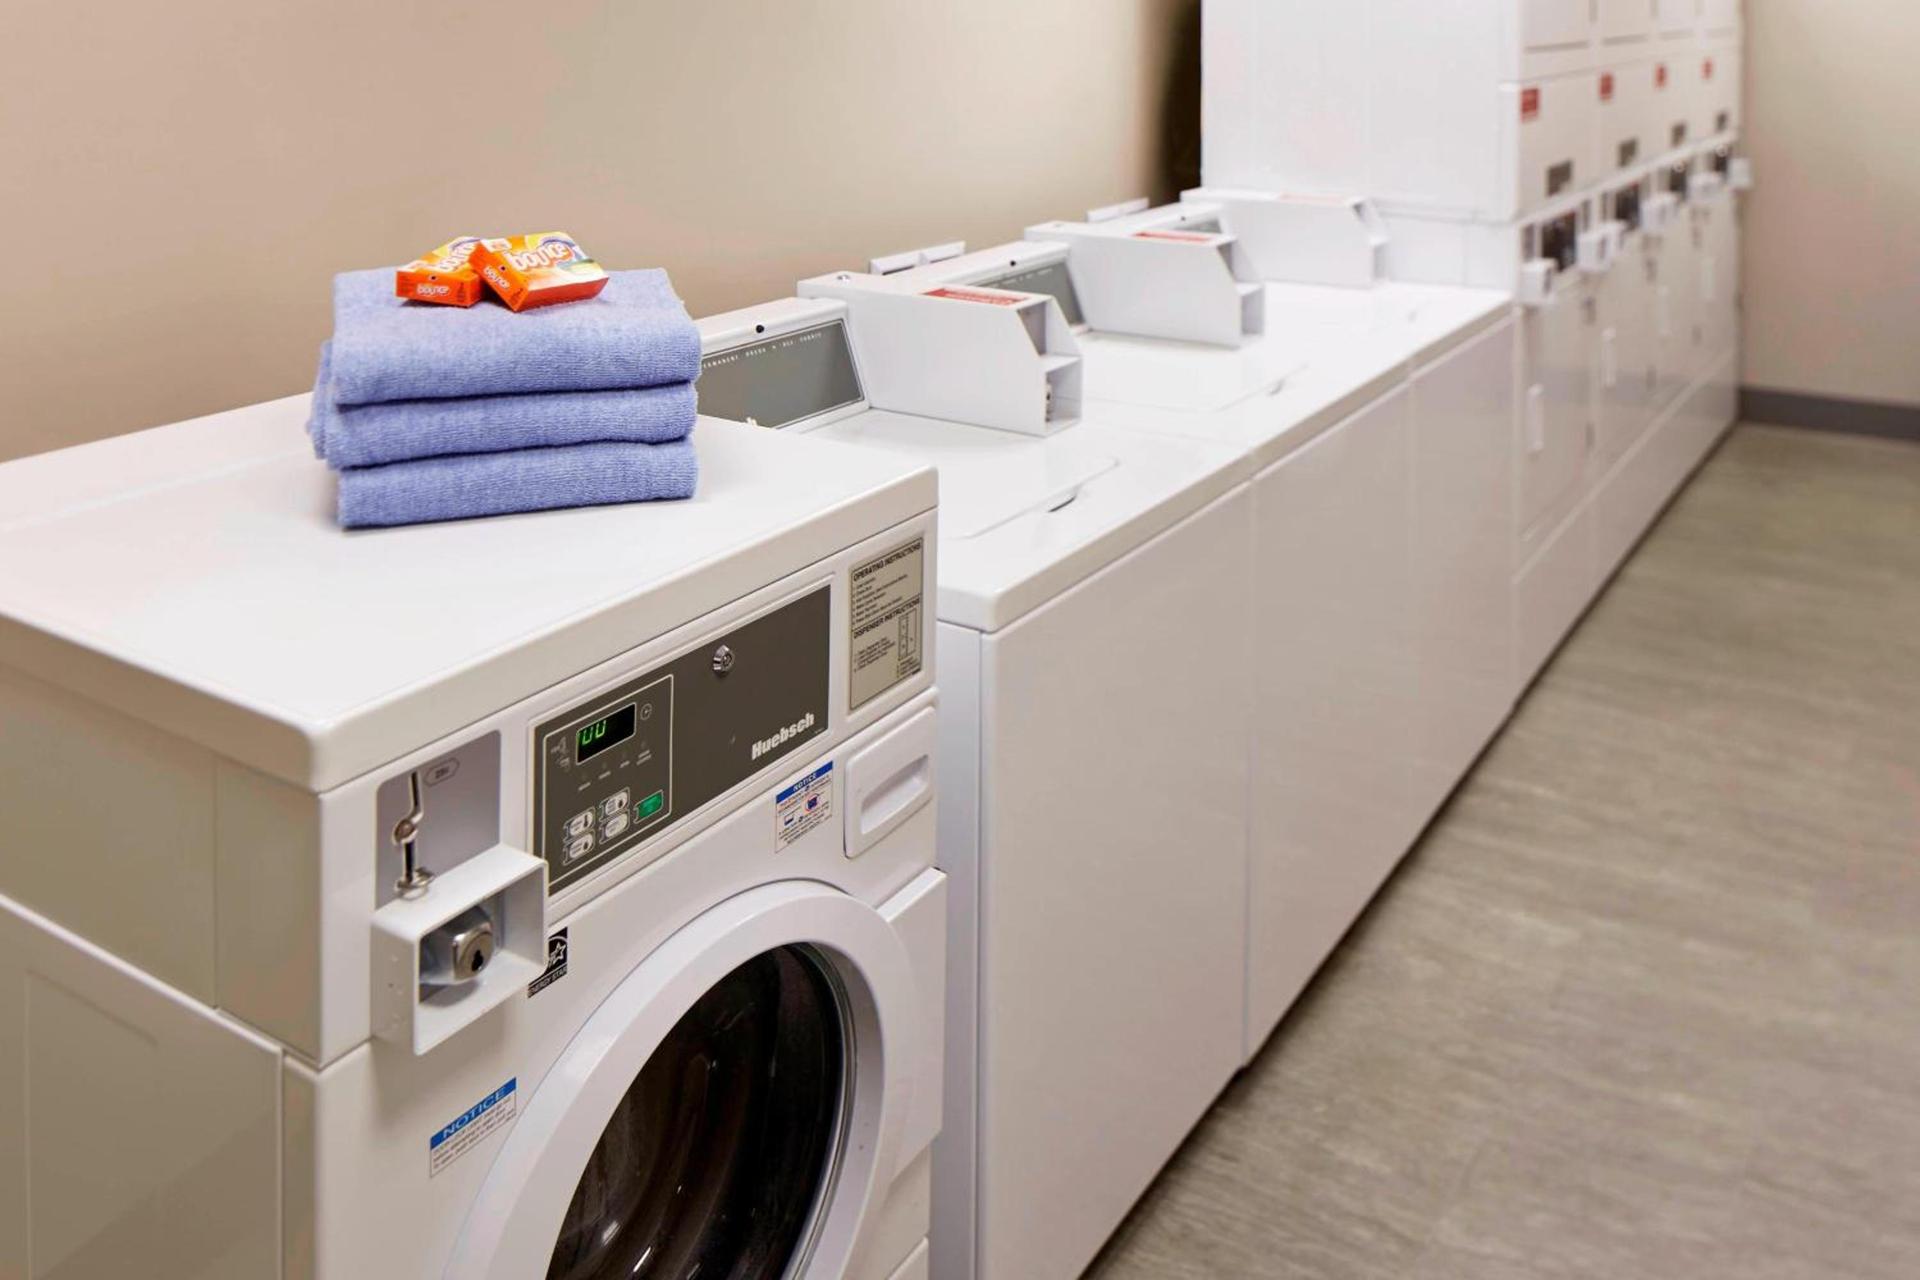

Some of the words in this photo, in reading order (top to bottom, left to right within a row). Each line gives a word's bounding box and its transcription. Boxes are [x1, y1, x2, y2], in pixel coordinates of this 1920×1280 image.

[853, 560, 884, 582] OPERATING
[884, 541, 921, 567] INSTRUCTIONS
[752, 712, 815, 760] Huebsch
[442, 1086, 509, 1139] NOTICE
